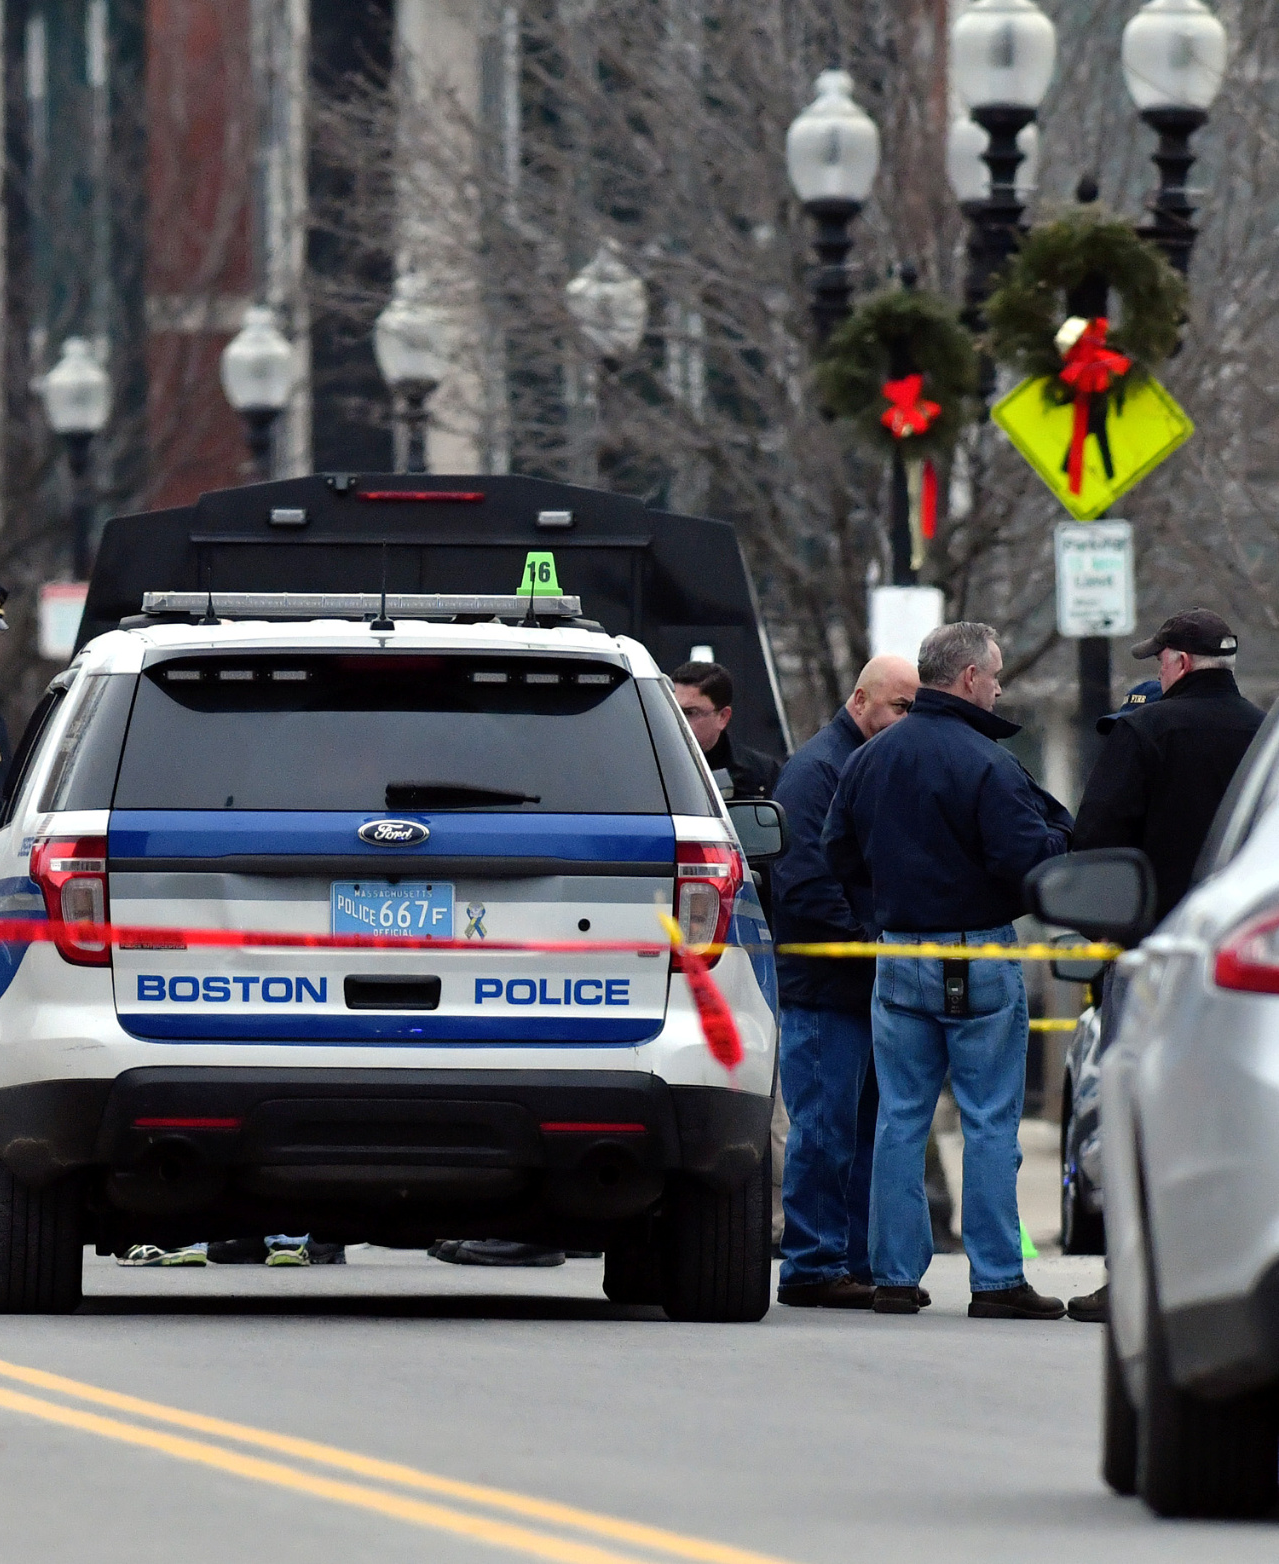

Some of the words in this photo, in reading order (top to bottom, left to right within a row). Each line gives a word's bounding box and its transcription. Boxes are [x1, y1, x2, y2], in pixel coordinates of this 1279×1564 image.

[527, 561, 551, 583] 16
[374, 823, 413, 841] Ford
[354, 889, 433, 898] MASSACHUSETTS
[337, 893, 377, 927] POLICE
[379, 900, 448, 928] 667F
[373, 928, 414, 937] OFFICIAL
[136, 974, 328, 1003] BOSTON
[474, 978, 630, 1006] POLICE
